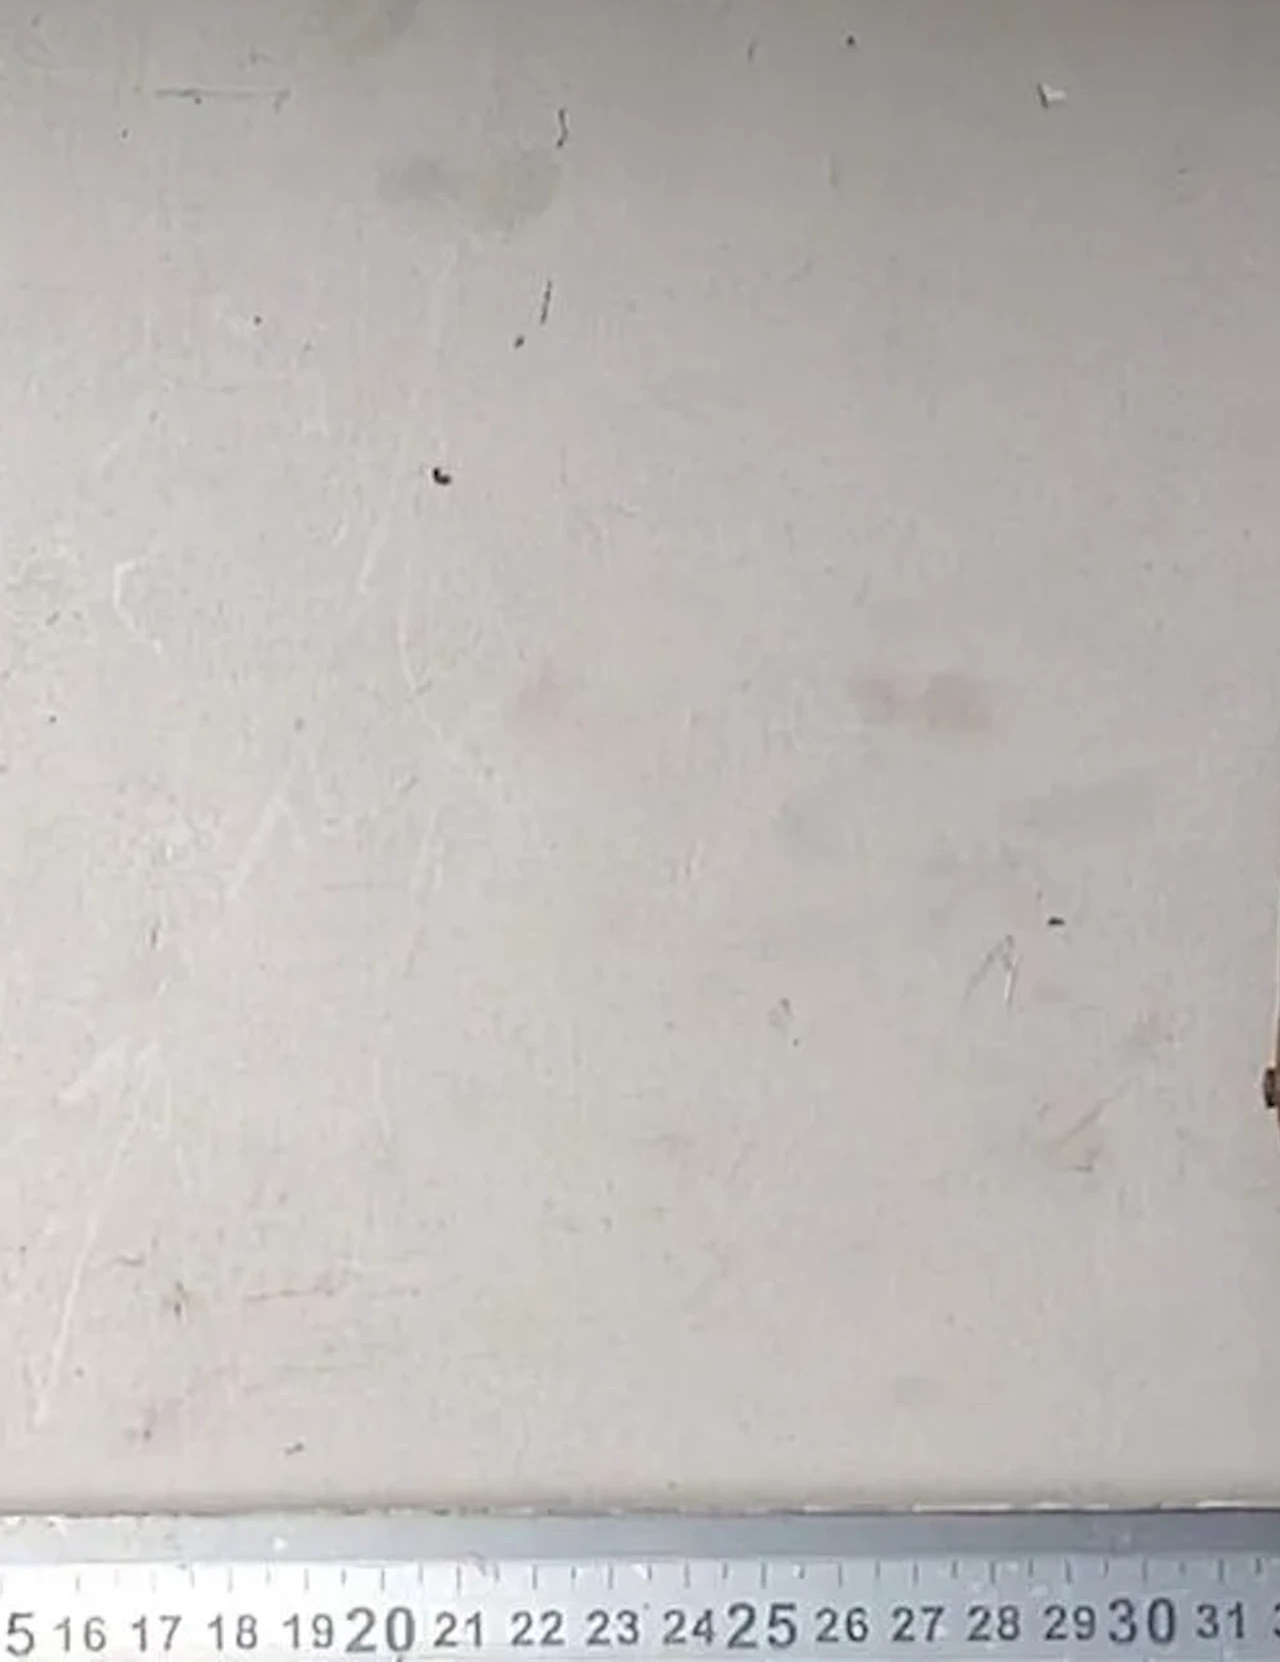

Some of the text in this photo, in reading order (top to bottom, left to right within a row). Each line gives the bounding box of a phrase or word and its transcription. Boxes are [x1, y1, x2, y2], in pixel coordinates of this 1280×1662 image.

[52, 1614, 108, 1654] 16
[130, 1613, 183, 1654] 17
[207, 1612, 259, 1653] 18
[281, 1612, 335, 1651] 19
[344, 1605, 416, 1655] 20
[432, 1609, 483, 1650] 21
[510, 1609, 566, 1648] 22
[585, 1608, 640, 1648] 23
[661, 1608, 717, 1648] 24
[725, 1601, 798, 1652] 25
[814, 1606, 870, 1644] 26
[890, 1605, 946, 1644] 27
[965, 1604, 1022, 1643] 28
[1043, 1604, 1097, 1642] 29
[1107, 1596, 1177, 1647] 30
[1195, 1600, 1245, 1640] 31
